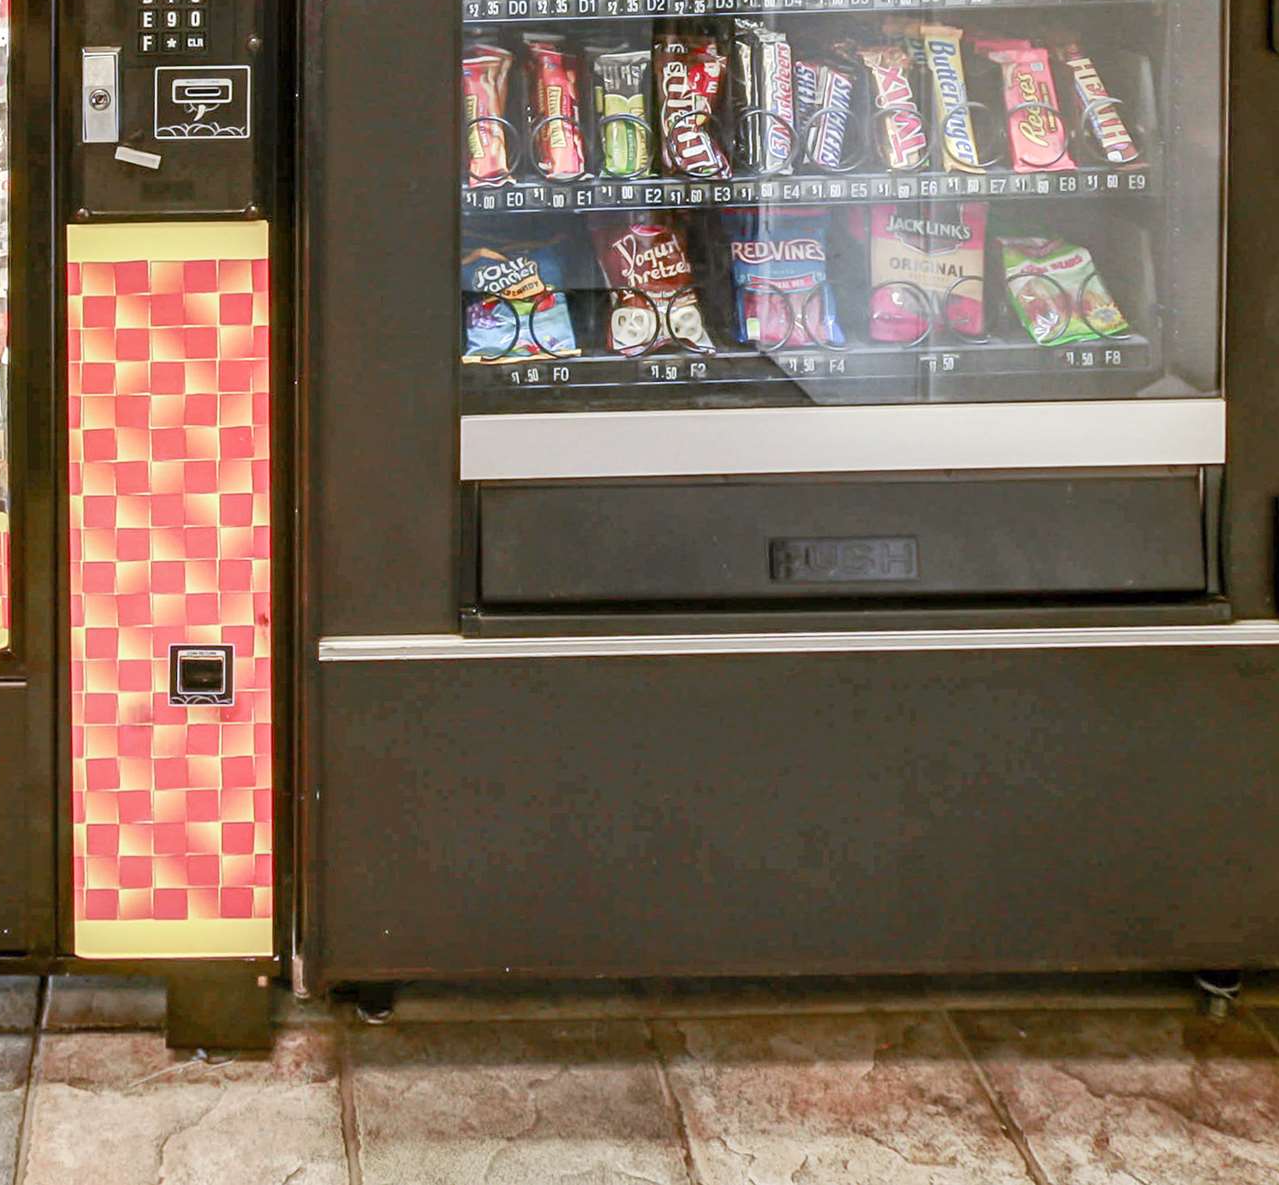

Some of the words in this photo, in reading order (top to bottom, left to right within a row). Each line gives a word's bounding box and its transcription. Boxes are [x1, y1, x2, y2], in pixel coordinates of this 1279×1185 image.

[508, 0, 528, 15] D0
[144, 12, 153, 27] E
[168, 12, 177, 27] 9
[144, 36, 152, 52] F
[990, 179, 1007, 194] E7
[507, 192, 523, 207] E0
[715, 187, 730, 202] E3
[886, 215, 924, 233] JACK
[731, 242, 769, 262] RED
[773, 240, 826, 261] VINES
[889, 256, 965, 277] ORIGINAL
[1106, 351, 1121, 365] F8
[553, 368, 569, 382] F0
